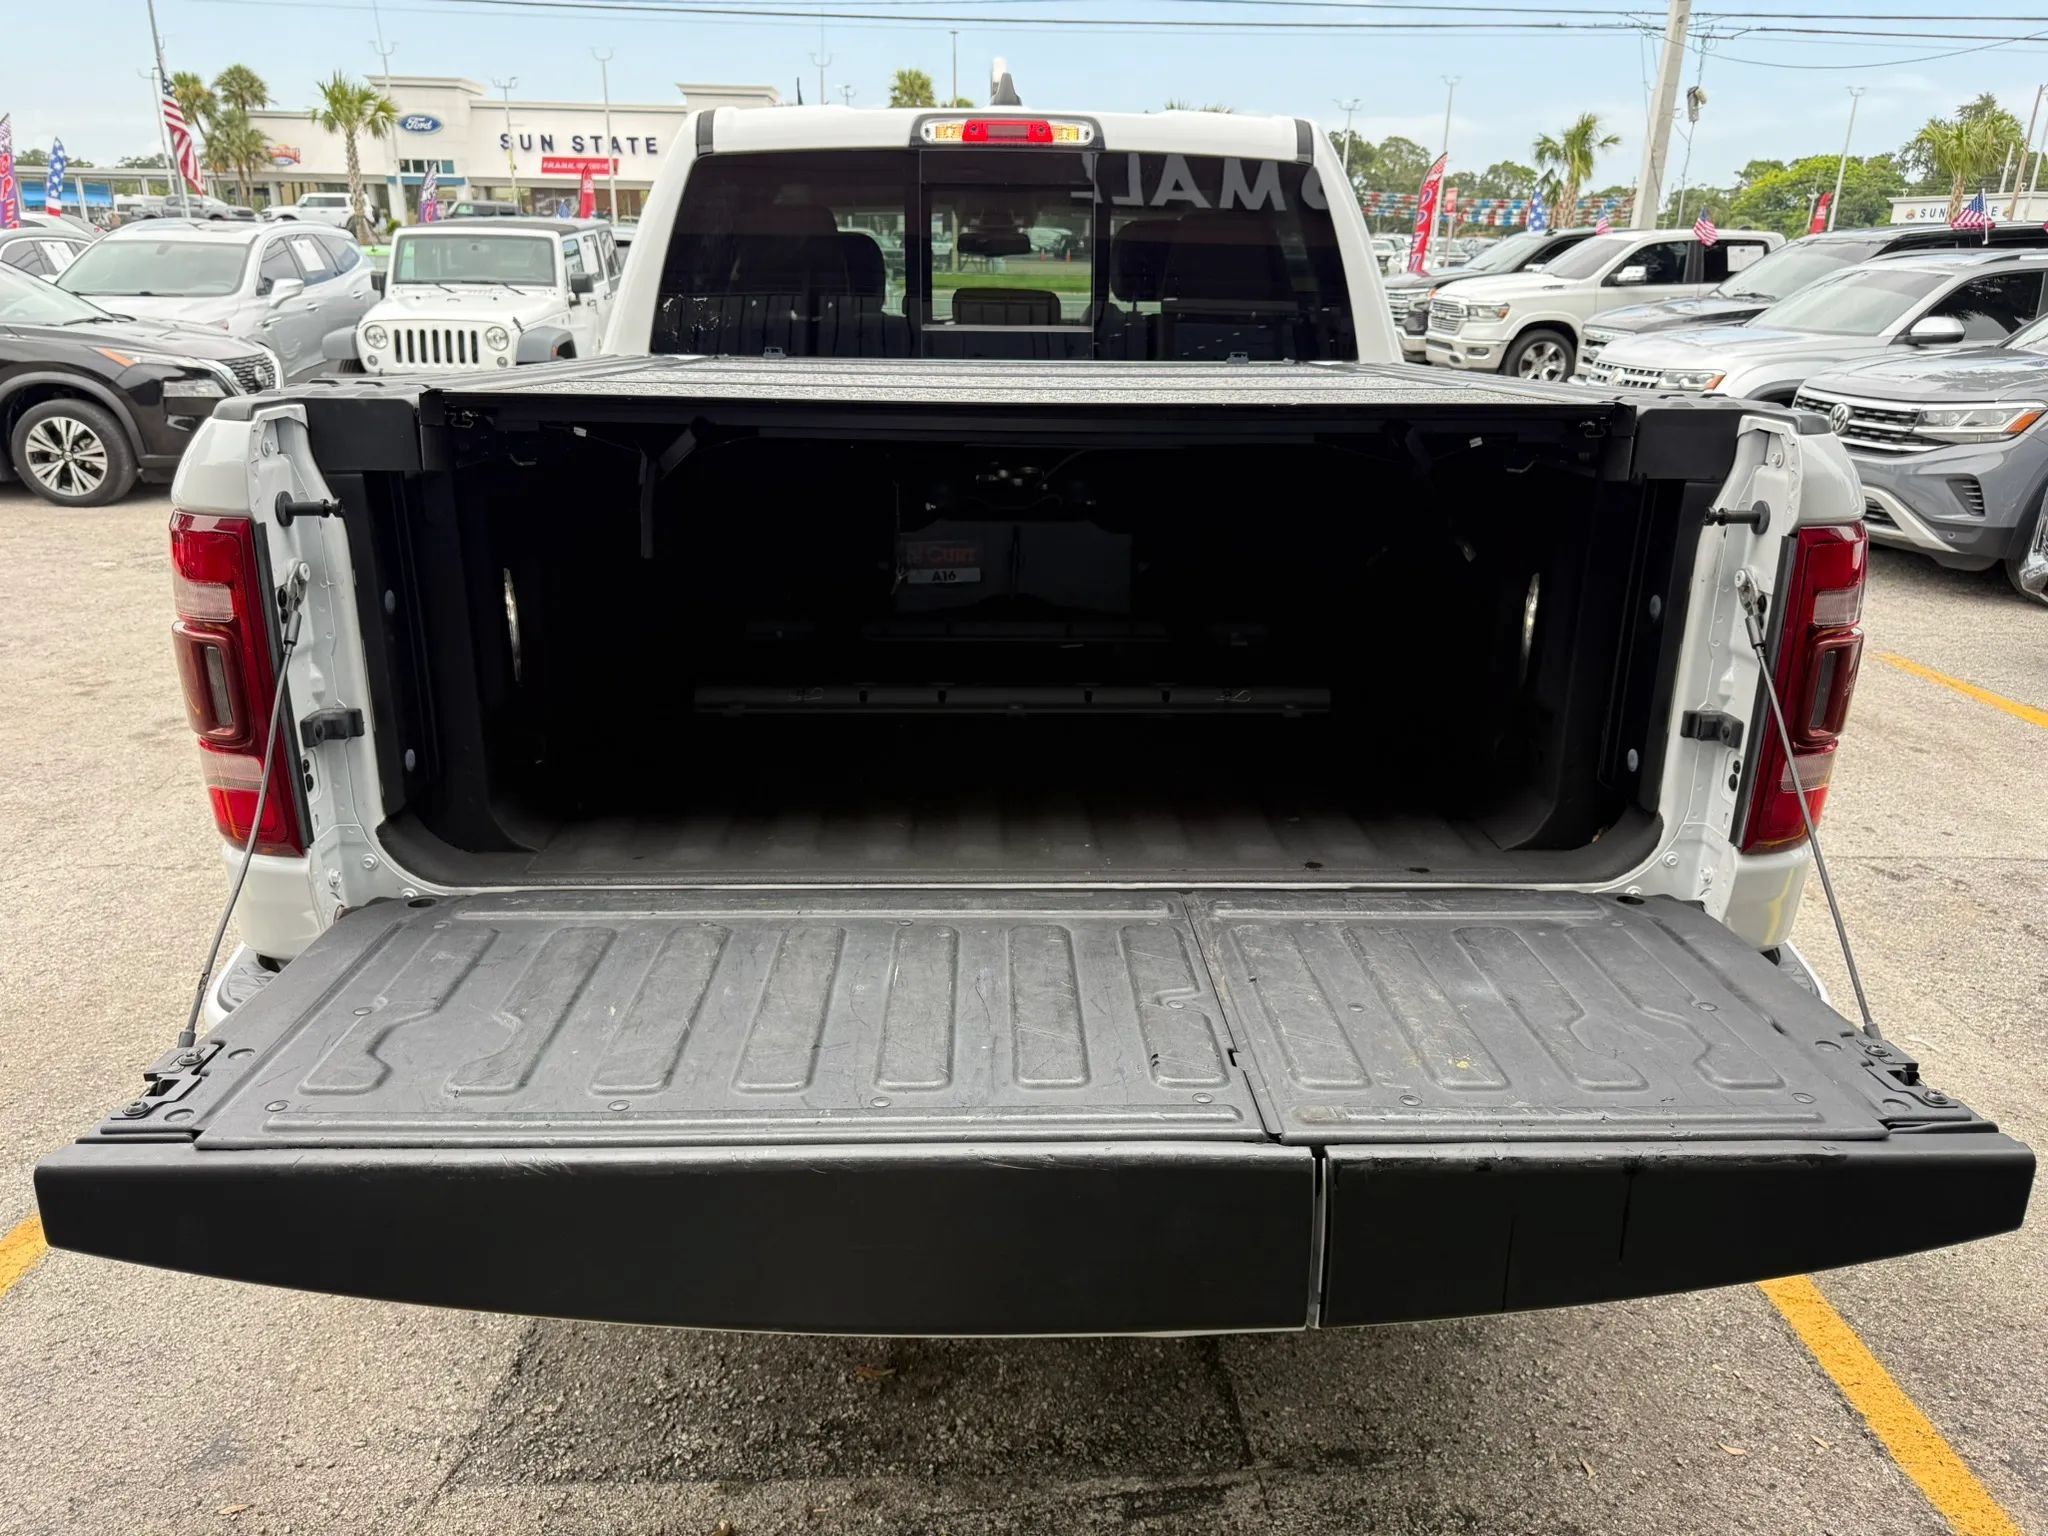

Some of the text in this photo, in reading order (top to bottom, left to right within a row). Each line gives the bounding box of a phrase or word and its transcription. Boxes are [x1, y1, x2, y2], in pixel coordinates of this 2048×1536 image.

[404, 115, 434, 130] Ford
[500, 133, 658, 154] SUN STATE
[1920, 208, 1946, 219] SUN
[932, 570, 957, 582] A16
